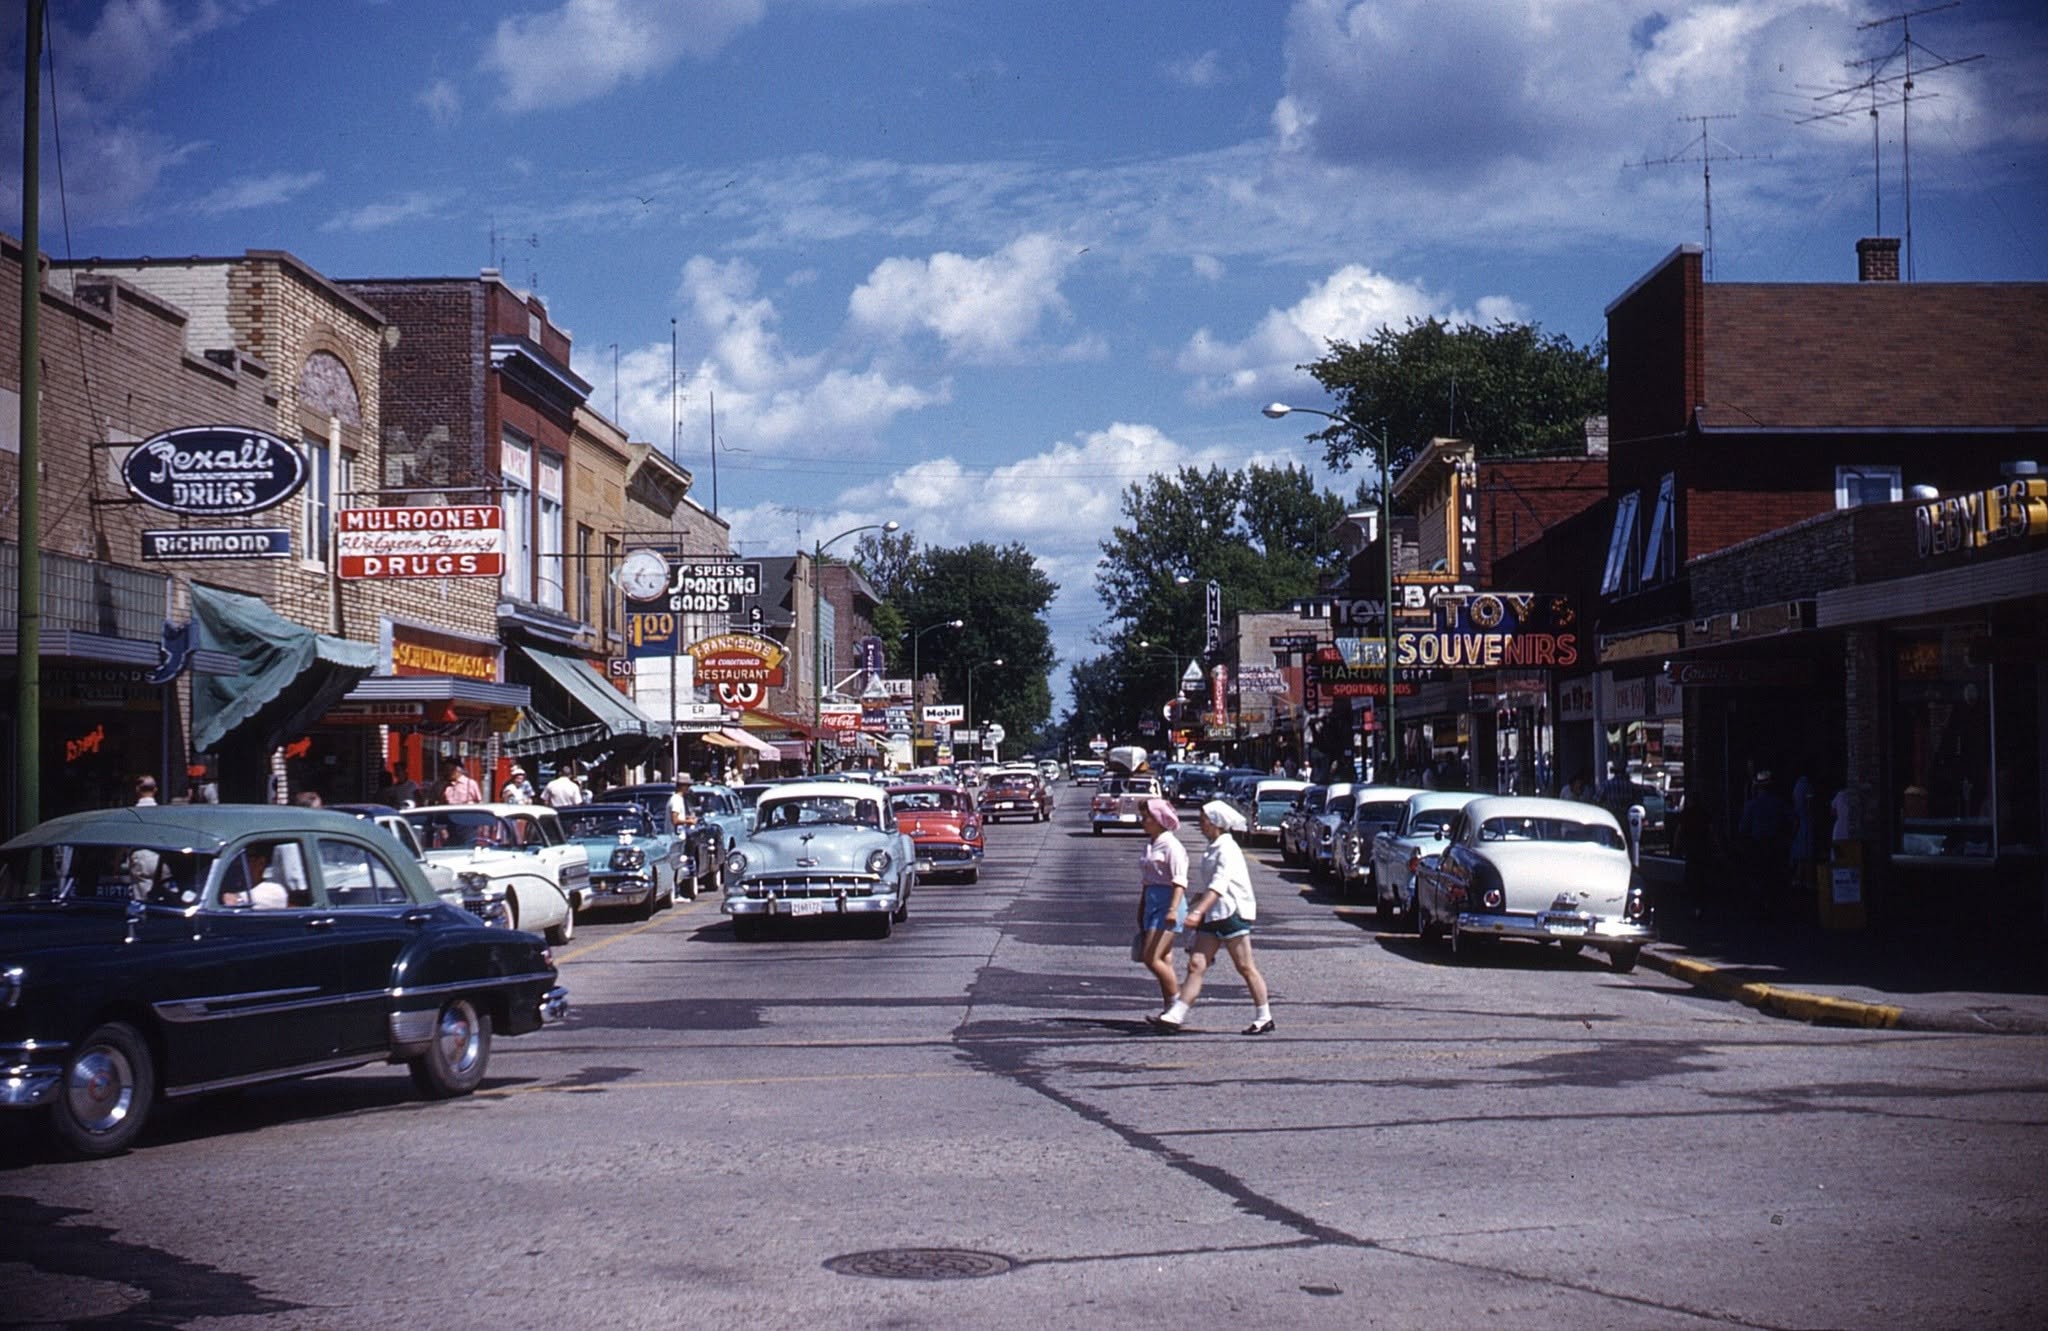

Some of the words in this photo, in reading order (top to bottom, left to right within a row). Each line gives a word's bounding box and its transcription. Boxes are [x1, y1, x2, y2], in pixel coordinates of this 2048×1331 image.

[149, 438, 274, 483] Rexall
[172, 481, 257, 506] DRUGS
[346, 508, 493, 530] MULROONEY
[1461, 472, 1476, 555] MINT
[153, 534, 272, 554] RICHMOND
[340, 534, 425, 553] Walgreen
[427, 534, 498, 552] Agency
[364, 555, 478, 575] DRUGS
[694, 564, 745, 576] SPIESS
[667, 564, 756, 595] SPORTING
[669, 595, 731, 612] GOODS
[693, 636, 773, 658] FRANCISCO'S
[1397, 633, 1577, 665] SOUVENIRS
[704, 658, 717, 666] AIR
[718, 658, 761, 666] CONDITIONED
[698, 669, 770, 681] RESTAURANT
[1333, 684, 1380, 696] SPORTING
[1380, 684, 1412, 695] GODS
[926, 707, 960, 717] Mobil
